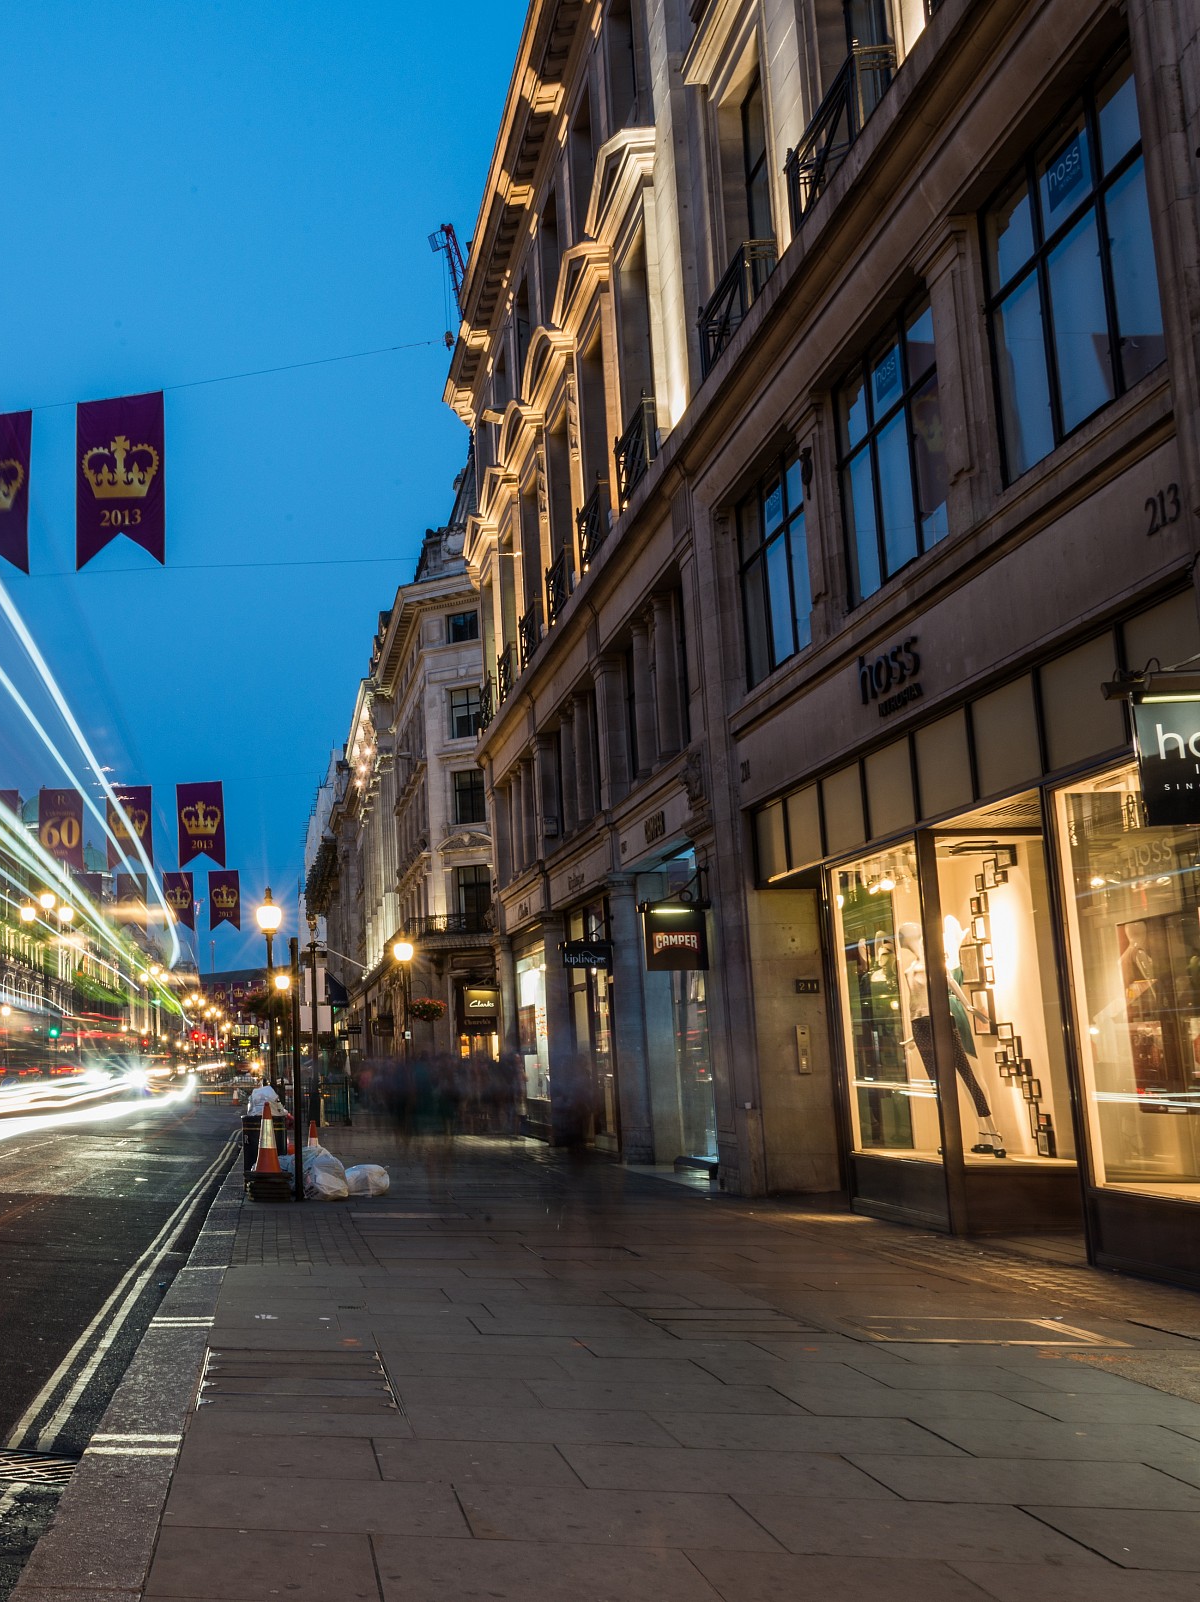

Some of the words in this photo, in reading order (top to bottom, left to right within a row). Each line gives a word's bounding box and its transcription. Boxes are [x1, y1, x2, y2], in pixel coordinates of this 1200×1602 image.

[1048, 146, 1080, 192] hoss
[1144, 483, 1181, 537] 213
[99, 508, 142, 527] 2013
[858, 635, 921, 705] hoss
[40, 816, 80, 849] 60
[191, 839, 214, 850] 2013
[218, 910, 233, 918] 2013
[655, 934, 699, 949] CAMPER
[564, 951, 601, 965] kipling
[799, 982, 818, 991] 211
[214, 991, 226, 1001] 60
[469, 1000, 495, 1008] Clarks
